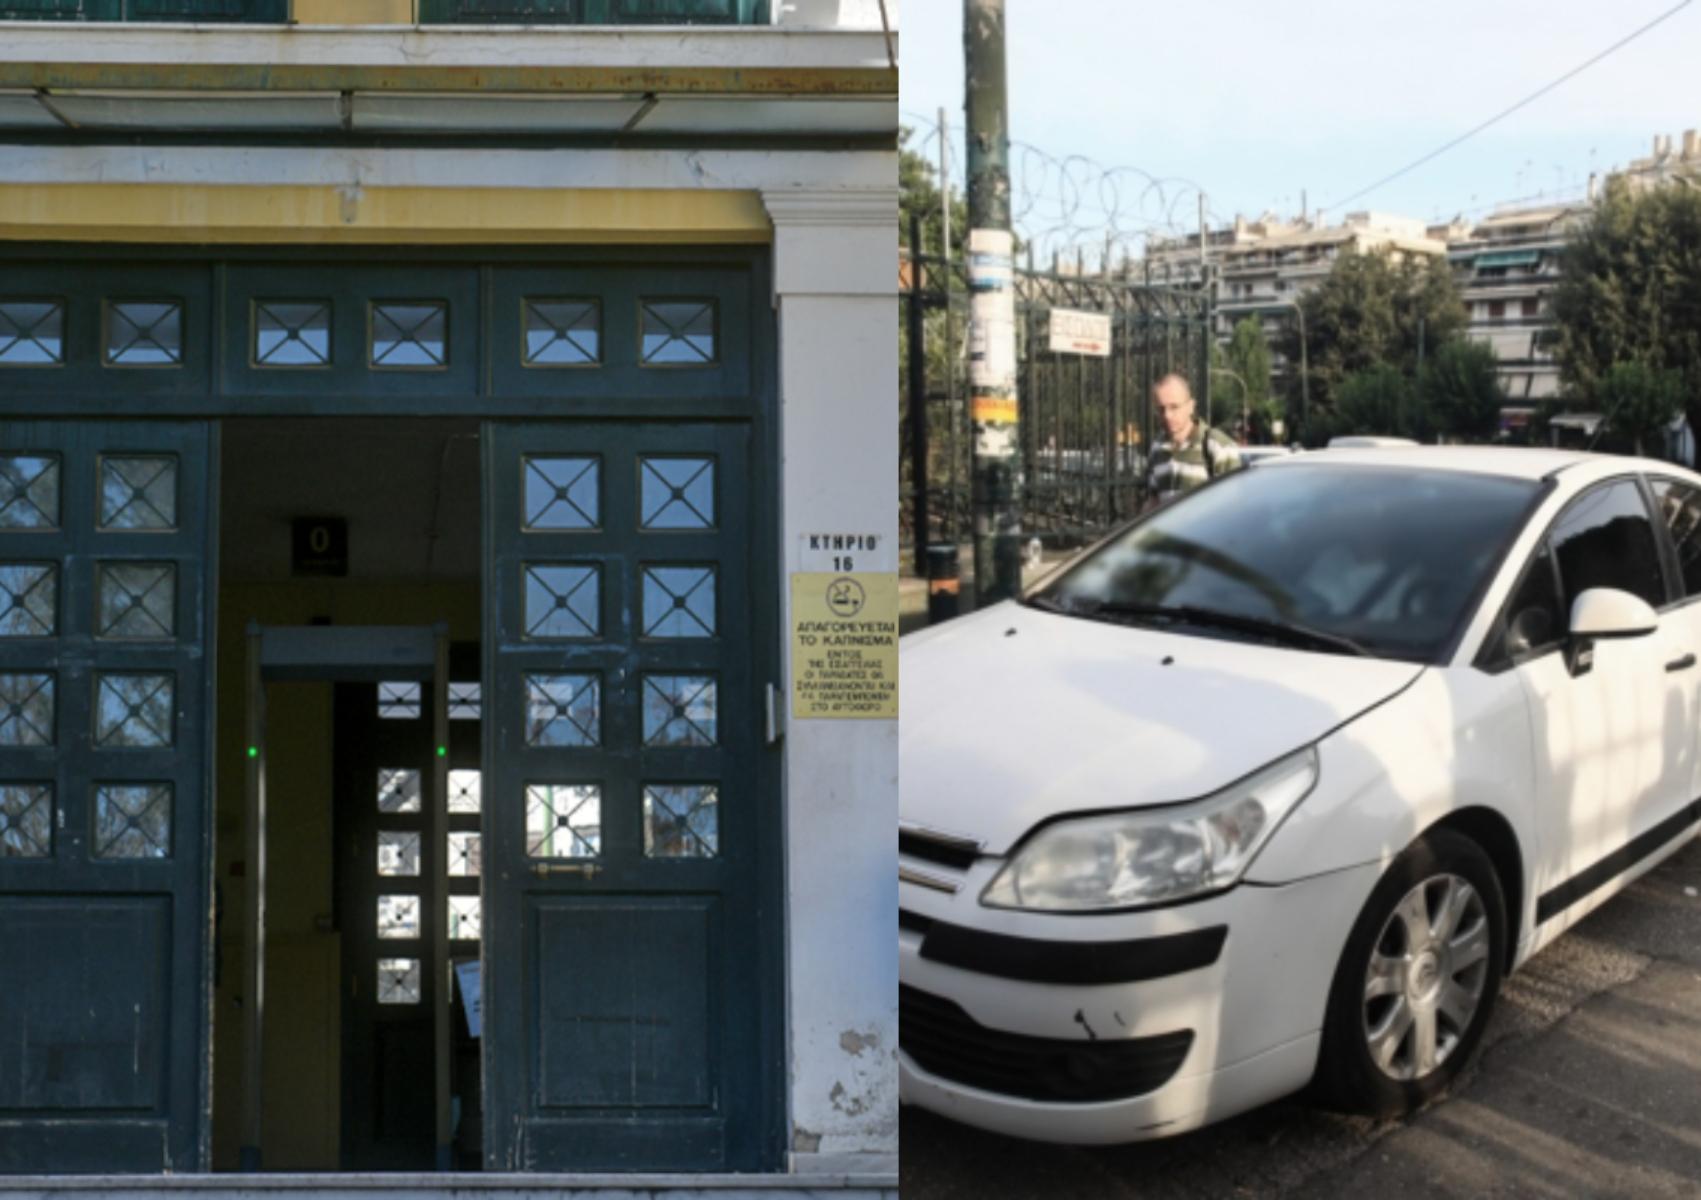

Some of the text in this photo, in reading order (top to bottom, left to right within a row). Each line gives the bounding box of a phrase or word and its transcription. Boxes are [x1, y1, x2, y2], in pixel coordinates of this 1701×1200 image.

[810, 534, 876, 551] ΚΤΗΡΙΟ
[833, 556, 853, 572] 16
[797, 622, 895, 633] ΑΠΑΓΟΡΕΥΕΤΑΙ
[799, 635, 893, 646] ΤΟ ΚΑΠΝΙΣΜΑ
